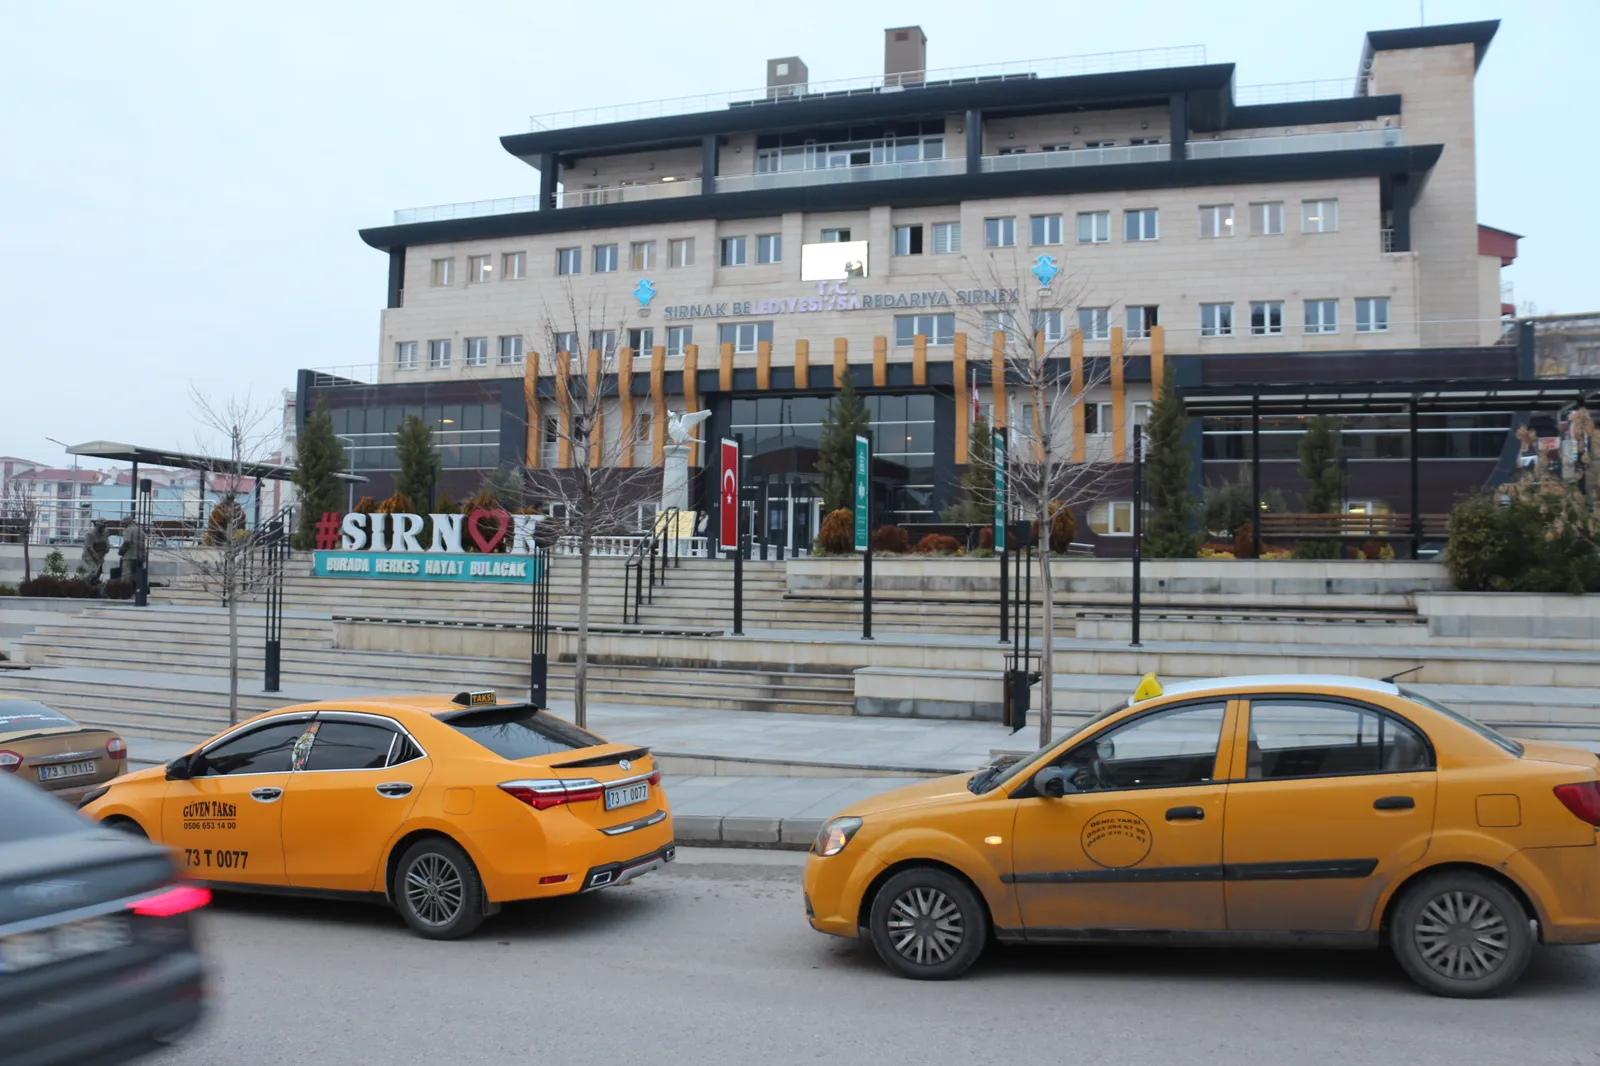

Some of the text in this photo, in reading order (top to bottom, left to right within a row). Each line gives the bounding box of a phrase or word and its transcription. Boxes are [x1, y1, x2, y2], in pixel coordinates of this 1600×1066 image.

[816, 279, 855, 295] T.C.
[326, 557, 526, 577] BURADA HERKES HAYAT BULACAK
[47, 762, 93, 777] 73 T 0115
[611, 786, 646, 805] 73 T 0077
[183, 801, 211, 817] GÜVEN
[184, 848, 248, 869] 73 T 0077
